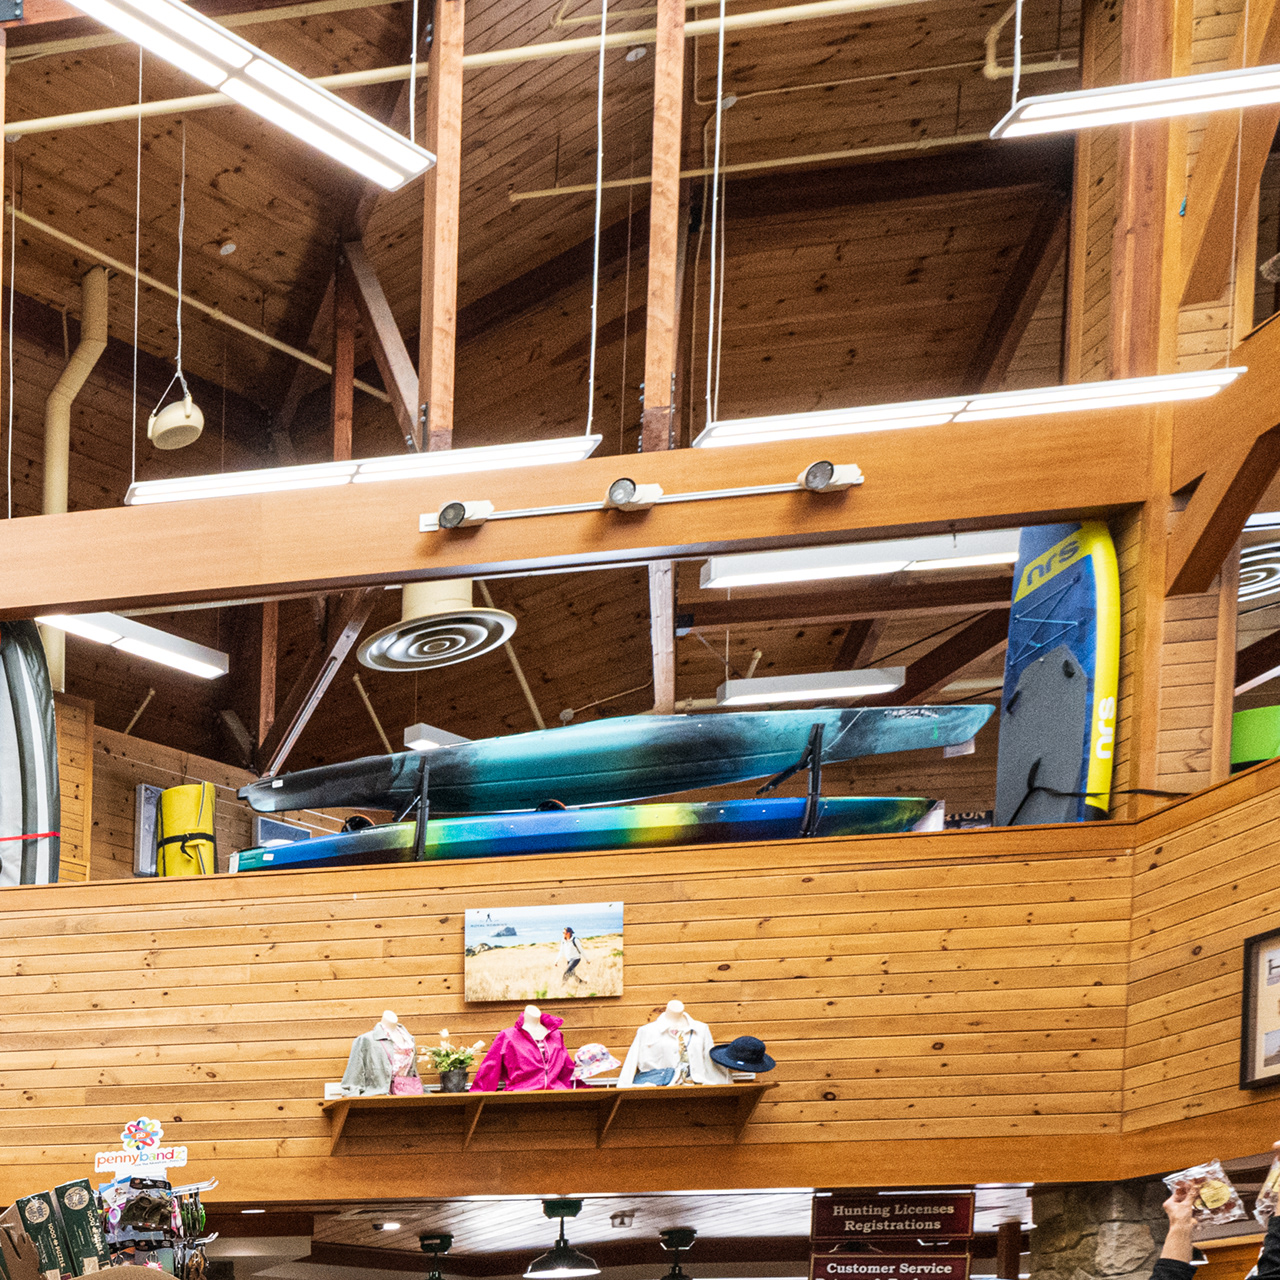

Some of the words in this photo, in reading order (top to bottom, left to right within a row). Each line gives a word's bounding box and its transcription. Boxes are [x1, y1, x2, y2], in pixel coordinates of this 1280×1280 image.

[1026, 540, 1080, 587] nrs
[1096, 696, 1115, 760] nrs
[97, 1149, 182, 1168] pennybandz
[833, 1205, 890, 1218] Hunting
[894, 1203, 955, 1215] Licenses
[844, 1219, 941, 1233] Registrations
[55, 1245, 66, 1268] PUZZLE
[826, 1262, 895, 1274] Customer
[899, 1262, 952, 1274] Service
